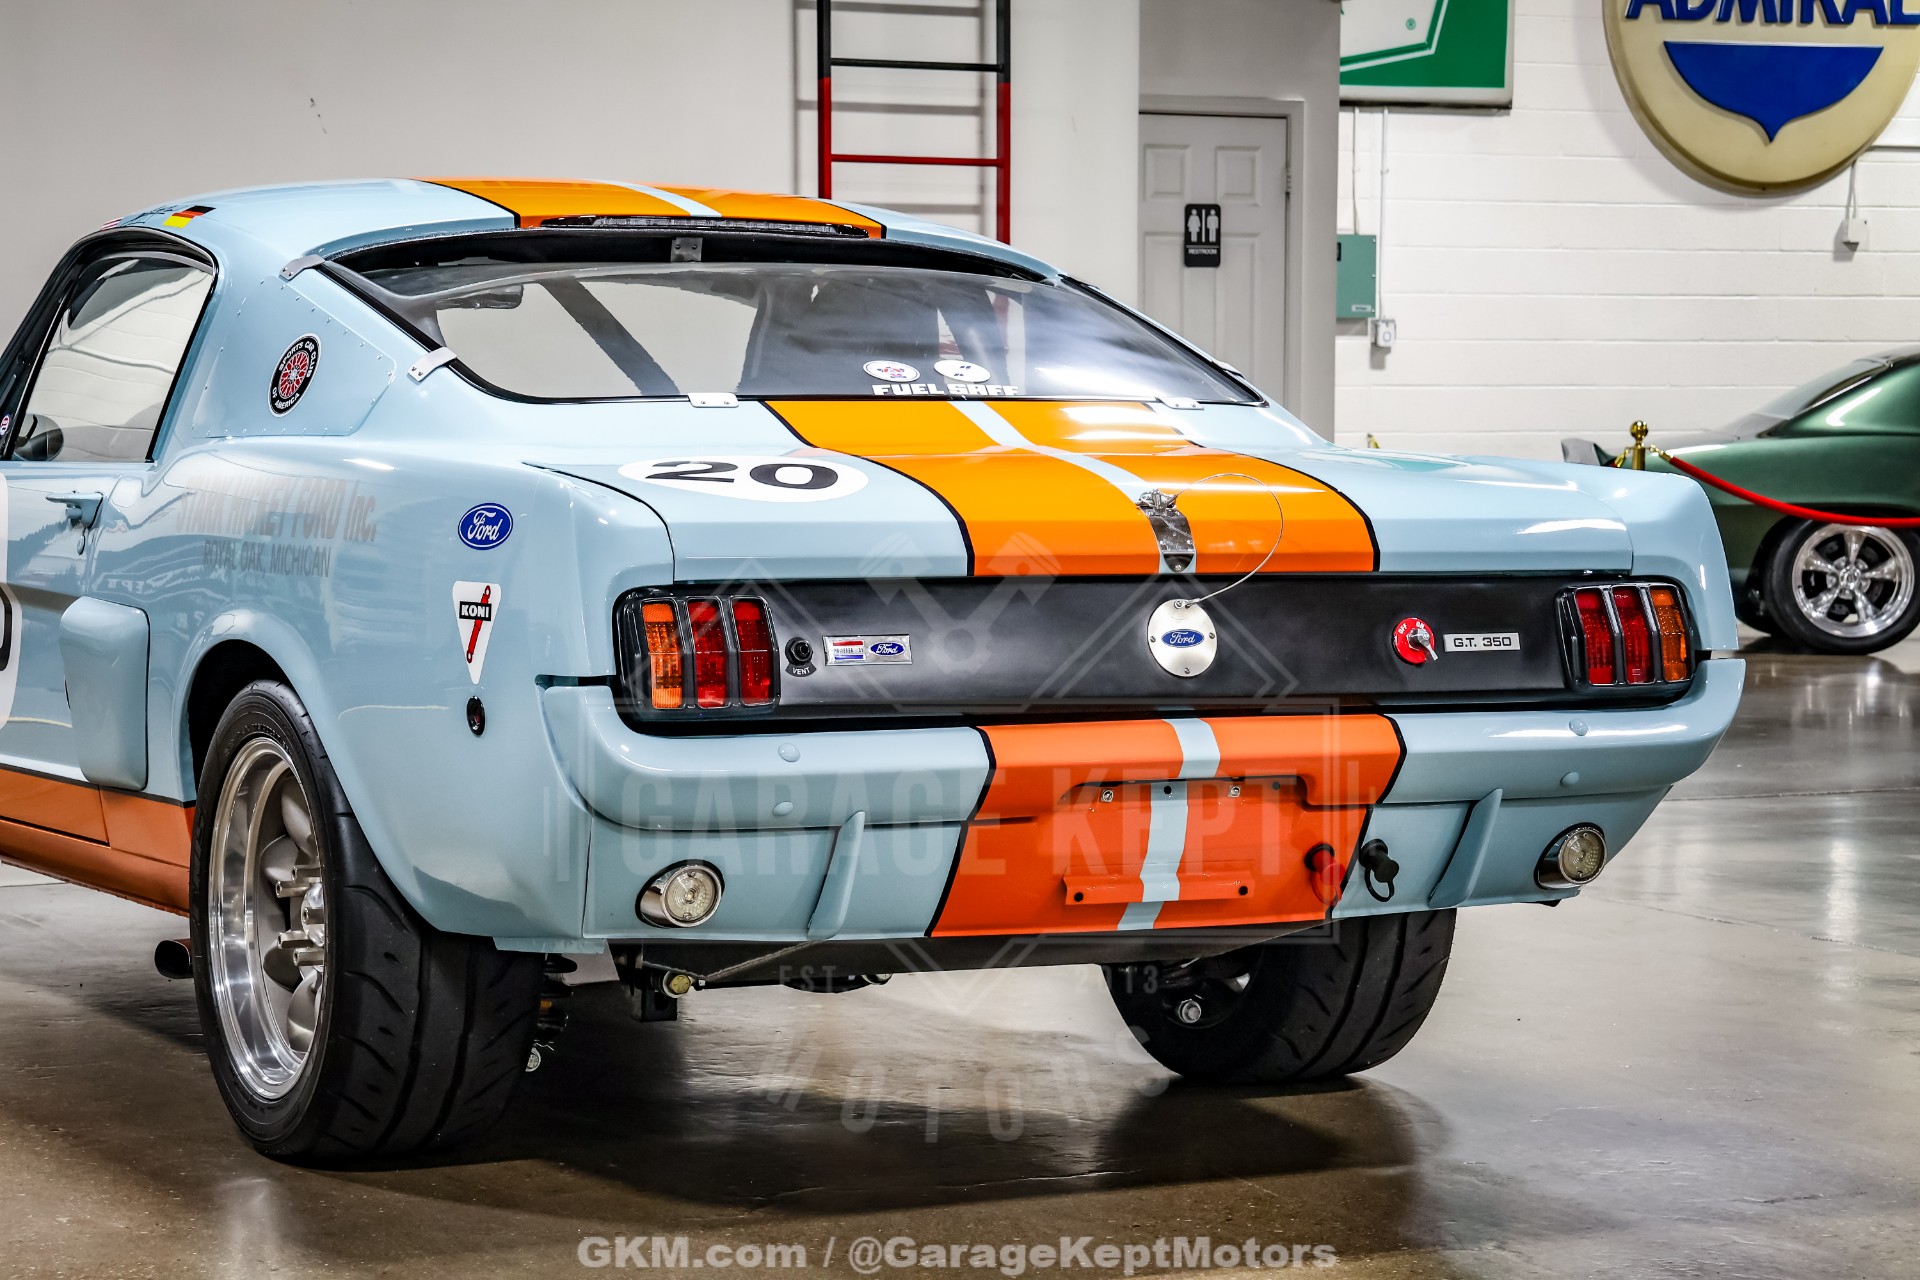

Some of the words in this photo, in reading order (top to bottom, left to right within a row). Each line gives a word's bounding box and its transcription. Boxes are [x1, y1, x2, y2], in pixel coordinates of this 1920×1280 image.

[304, 340, 315, 353] CAR
[279, 341, 304, 372] SPORTS
[306, 351, 316, 378] CLUB
[272, 386, 278, 399] OF
[871, 383, 945, 396] FUEL
[274, 392, 300, 410] AMERICA
[645, 460, 839, 491] 20
[291, 477, 347, 540] FORD
[467, 509, 503, 541] Ford
[203, 539, 238, 571] ROYAL
[240, 540, 266, 579] OAK,
[270, 542, 333, 578] MICHIGAN
[461, 604, 490, 618] KONI
[1397, 623, 1408, 635] OFF
[1415, 621, 1425, 630] ON
[1169, 631, 1196, 644] Ford
[1453, 637, 1477, 648] G.T.
[1482, 636, 1512, 647] 350
[874, 643, 899, 654] Ford
[792, 666, 811, 675] VENT
